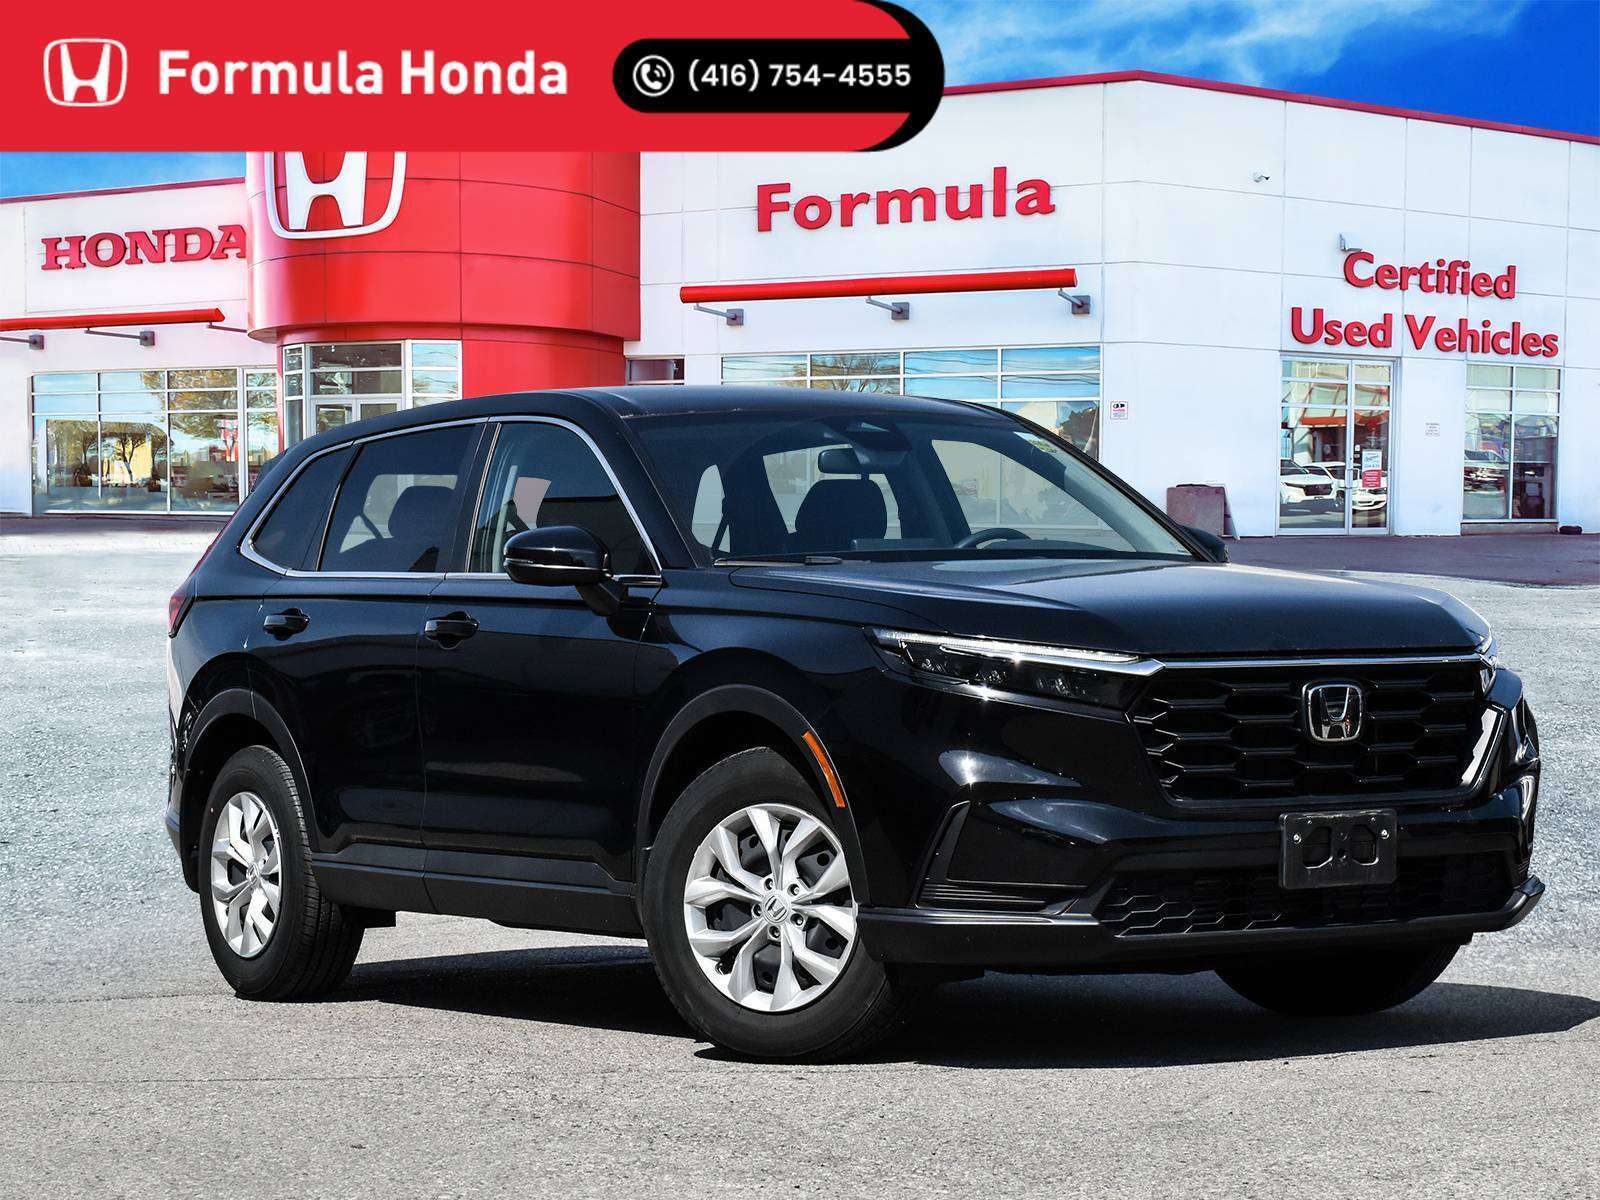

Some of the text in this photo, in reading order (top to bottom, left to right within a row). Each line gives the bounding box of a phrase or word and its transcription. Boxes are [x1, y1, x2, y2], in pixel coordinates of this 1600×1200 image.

[757, 166, 1056, 232] Formula
[41, 224, 247, 270] HONDA
[1343, 250, 1517, 299] Certified
[1291, 307, 1560, 358] Used Vehicles
